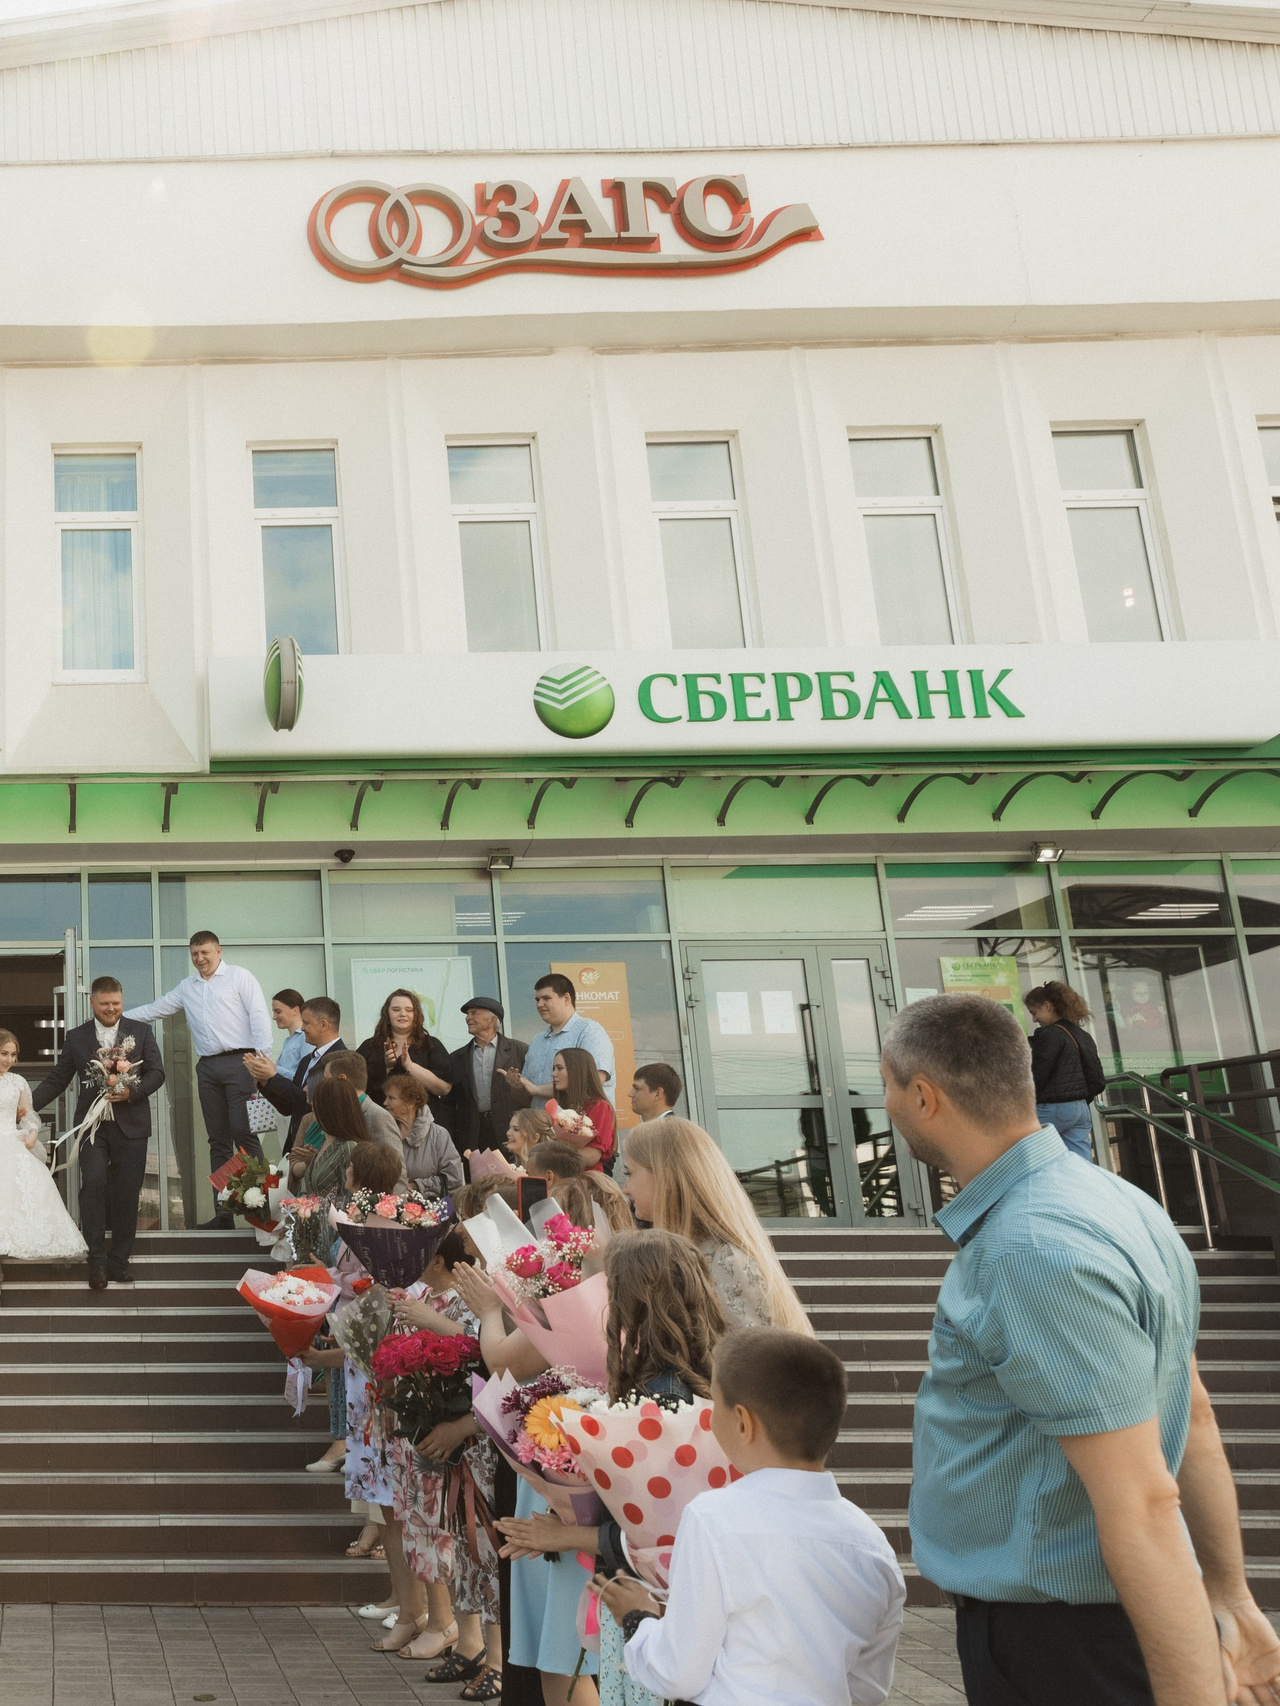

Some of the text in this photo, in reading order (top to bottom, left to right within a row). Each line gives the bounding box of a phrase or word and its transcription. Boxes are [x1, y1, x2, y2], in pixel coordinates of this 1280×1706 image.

[476, 174, 754, 250] ЗАГС
[637, 667, 1026, 723] СБЕРБАНК
[581, 971, 594, 980] 24
[576, 991, 620, 1001] НКОМАТ
